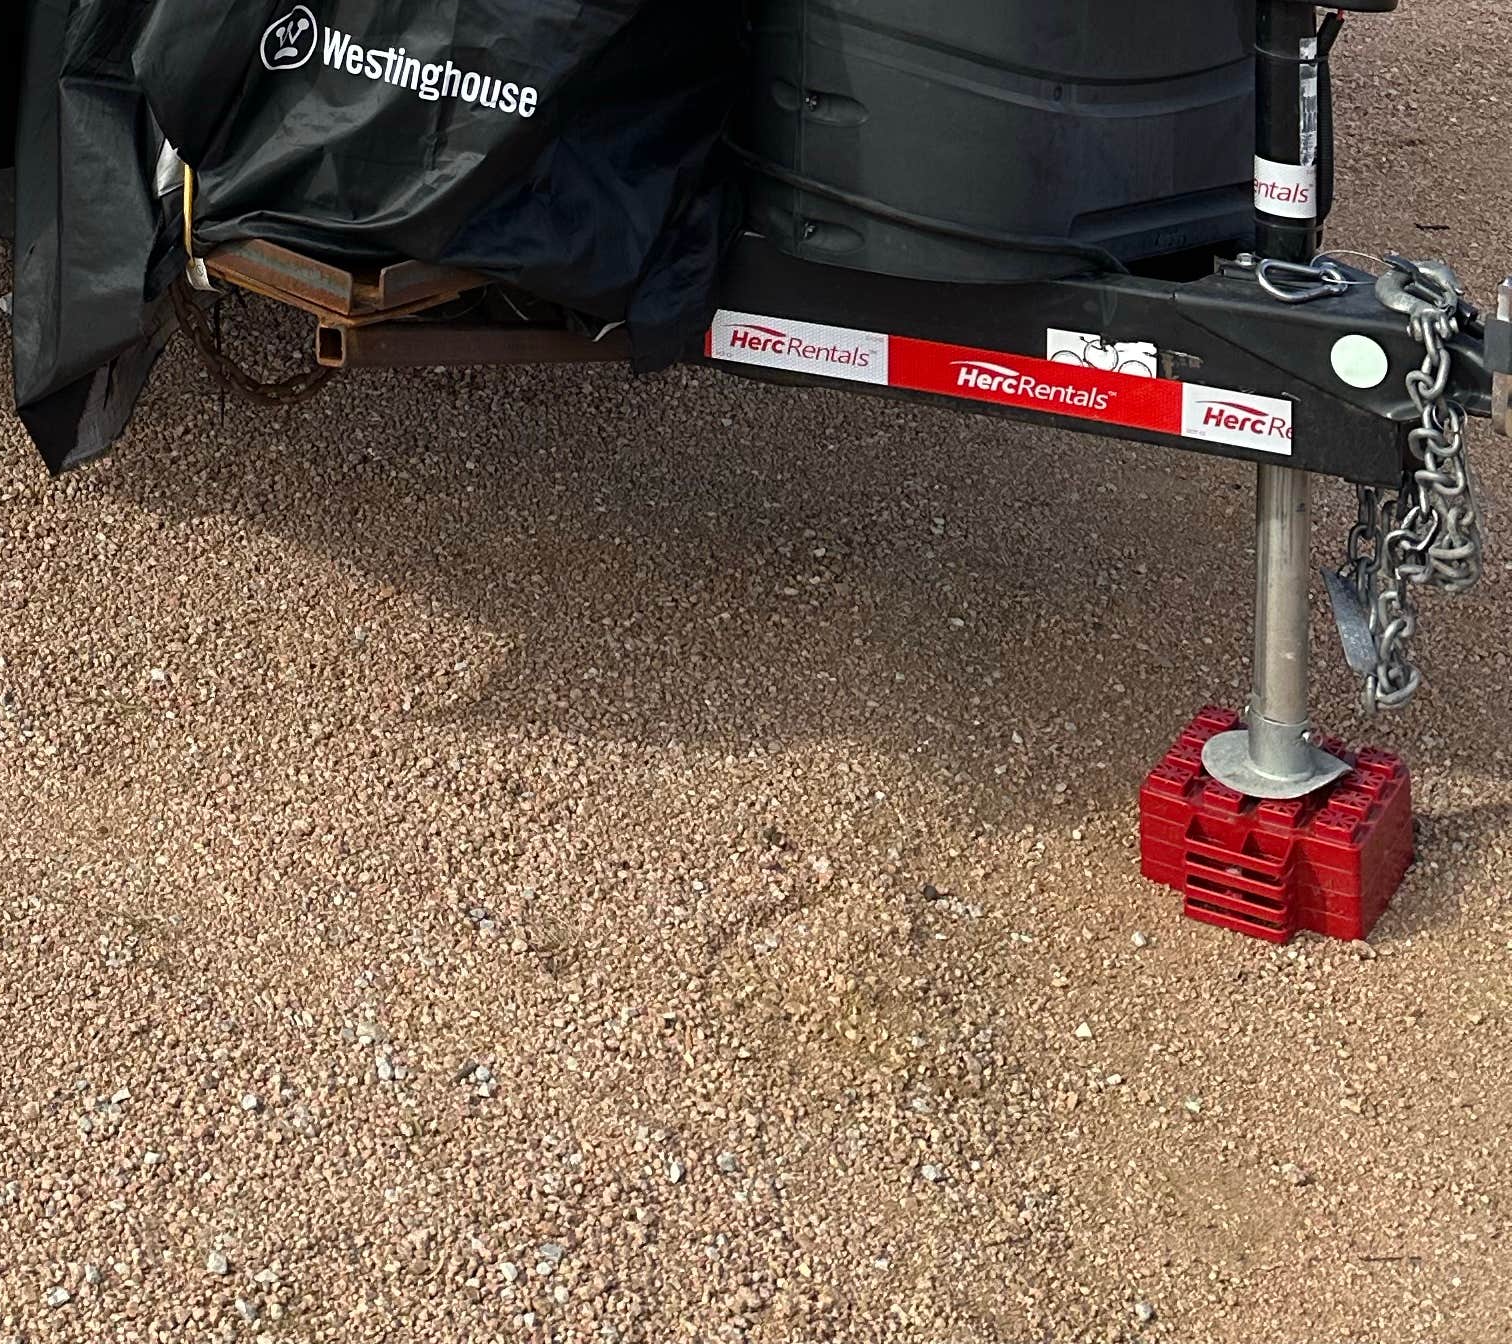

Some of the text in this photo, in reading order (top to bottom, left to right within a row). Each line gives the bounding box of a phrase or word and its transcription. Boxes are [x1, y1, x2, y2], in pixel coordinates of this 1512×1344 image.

[323, 26, 538, 118] Westinghouse
[730, 330, 870, 368] HercRentals
[957, 366, 1109, 411] HercRentals
